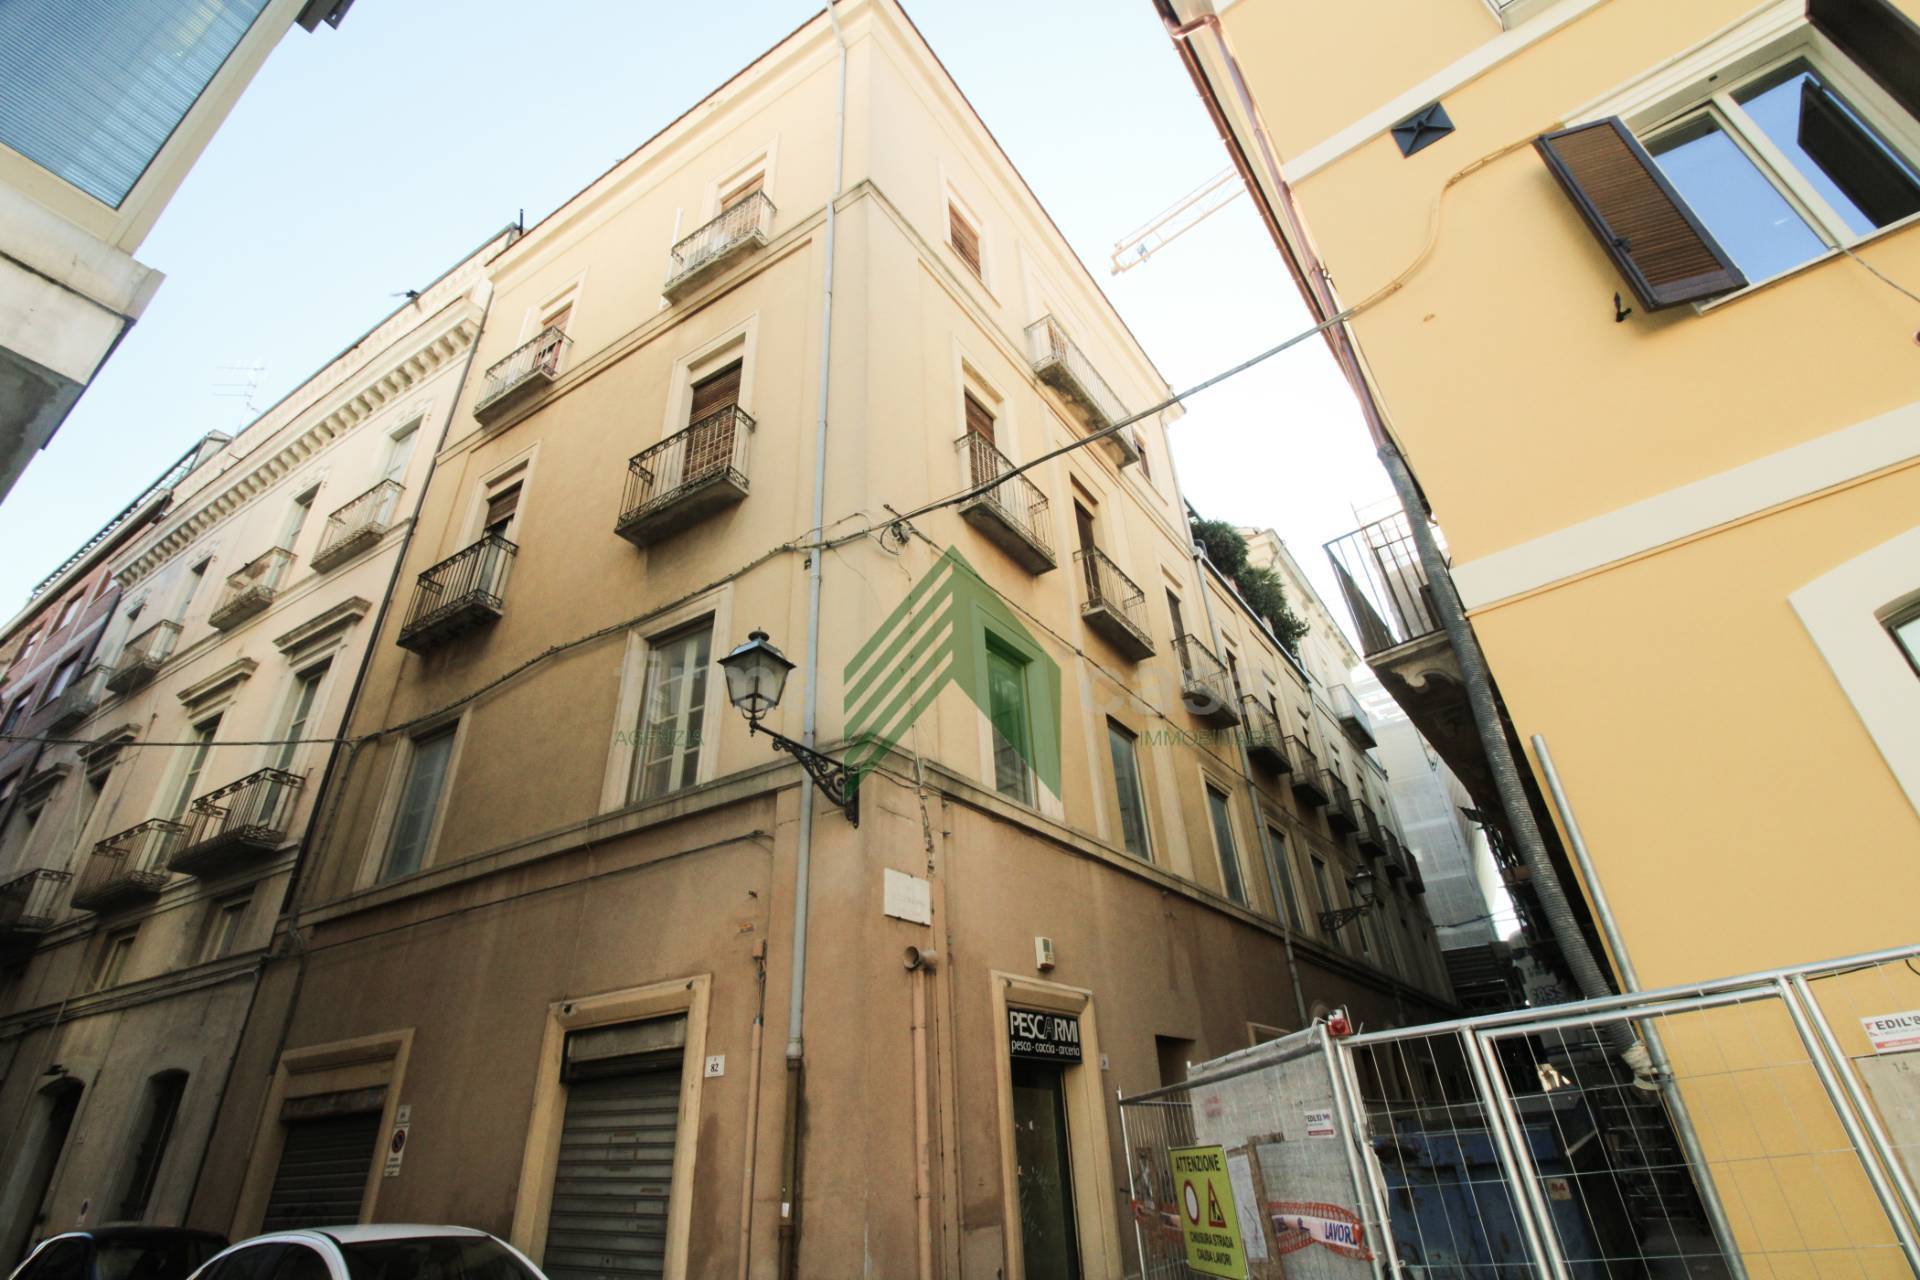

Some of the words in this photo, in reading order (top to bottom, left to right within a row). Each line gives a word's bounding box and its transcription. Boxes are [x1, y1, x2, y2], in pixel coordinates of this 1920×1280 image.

[1009, 1011, 1079, 1044] PESCARMI
[1011, 1040, 1032, 1054] pesca
[1035, 1042, 1055, 1054] caccia
[1058, 1045, 1080, 1057] arceria
[710, 1062, 720, 1073] 82
[1175, 1154, 1221, 1173] ATTENZIONE
